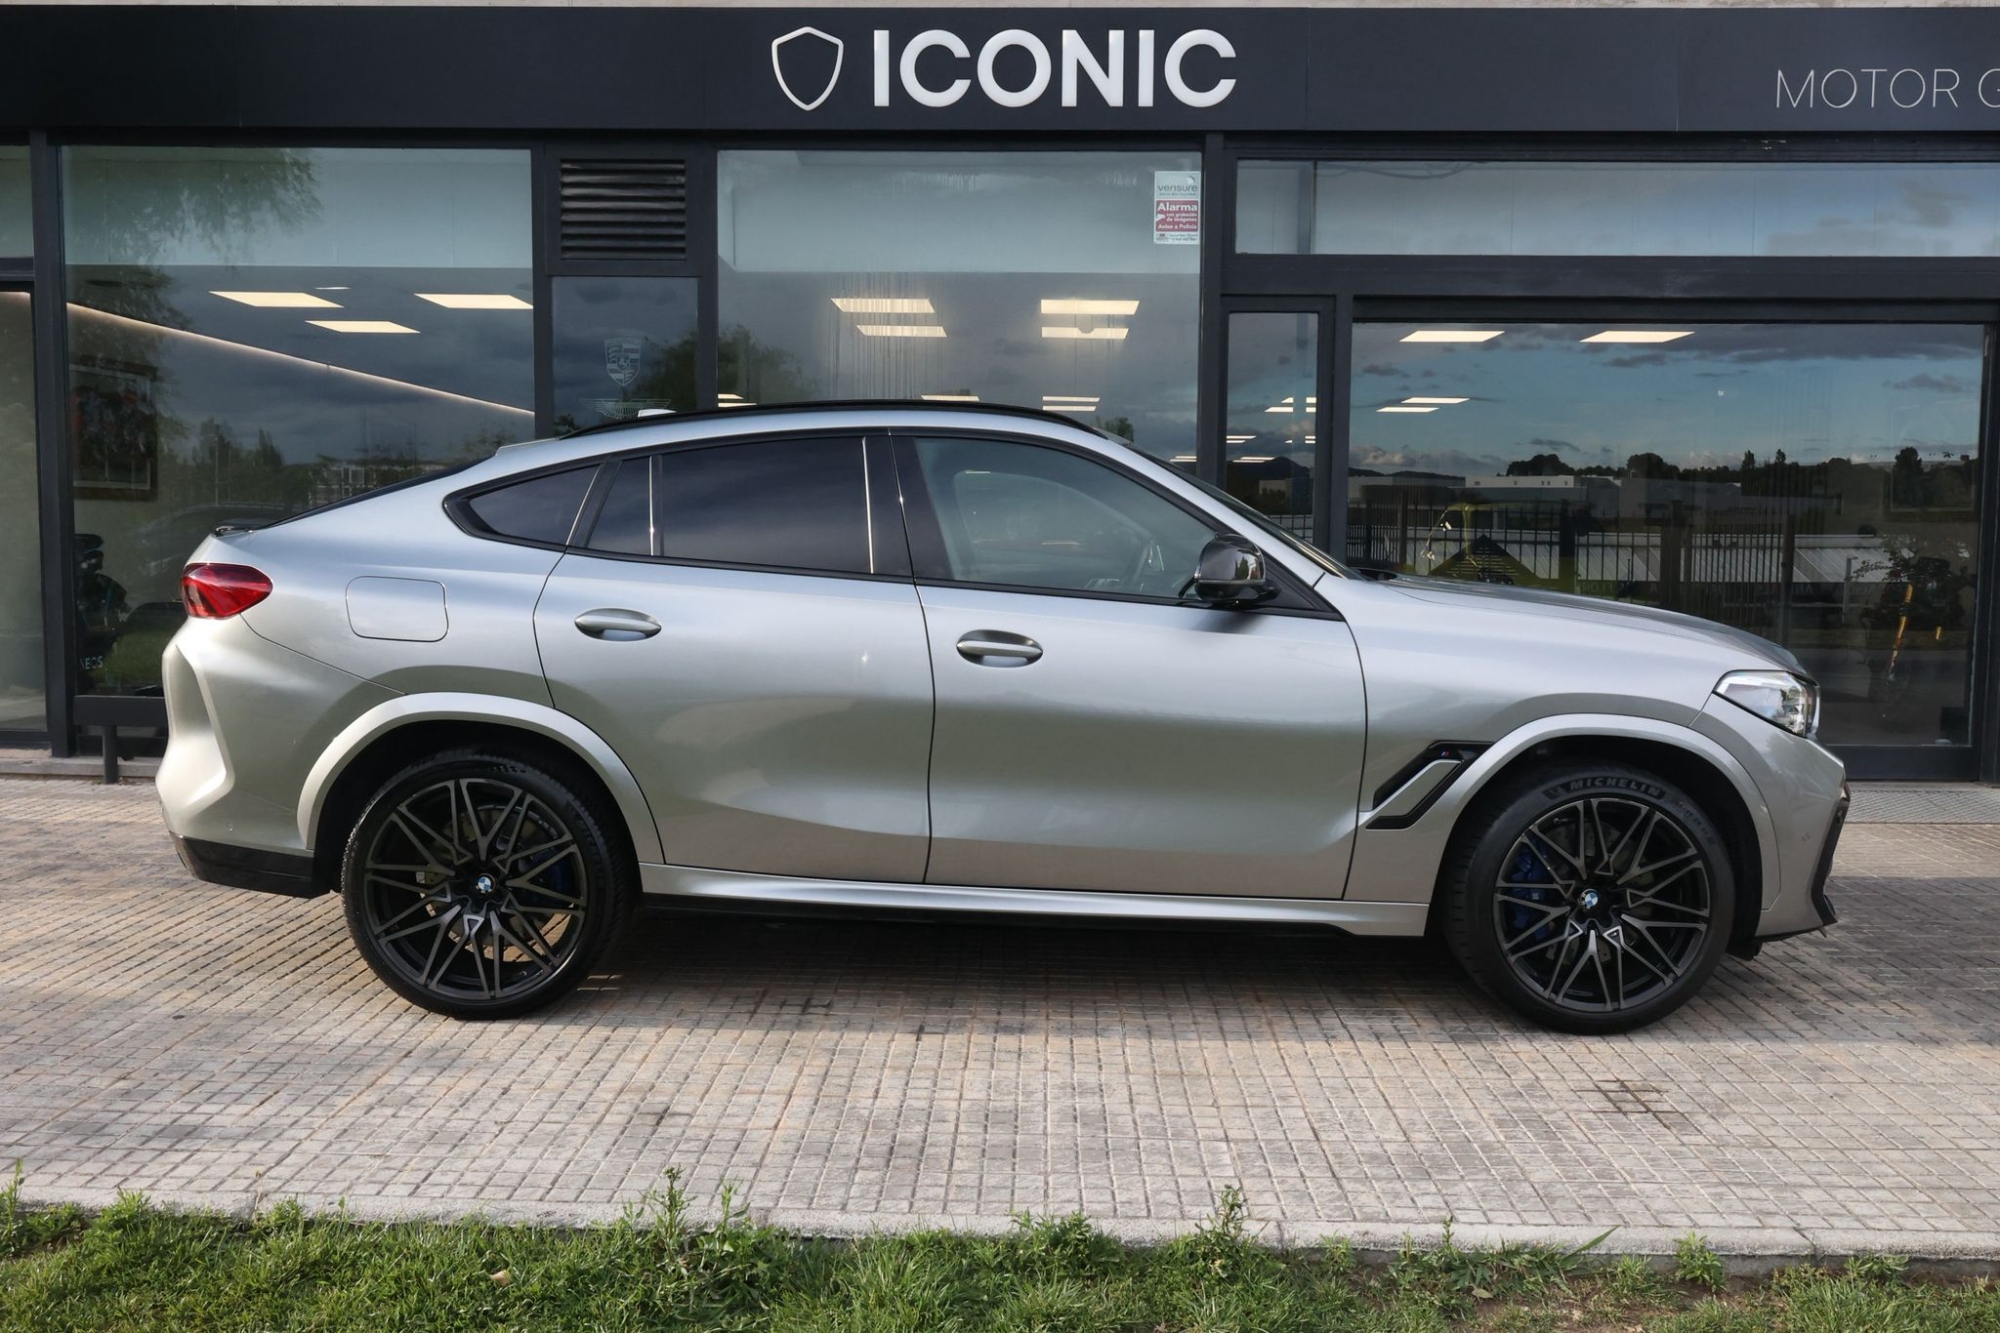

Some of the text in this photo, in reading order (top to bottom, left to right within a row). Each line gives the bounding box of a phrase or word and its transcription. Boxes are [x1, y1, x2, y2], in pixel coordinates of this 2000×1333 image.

[873, 28, 1237, 108] ICONIC
[1776, 68, 1960, 108] MOTOR
[1157, 184, 1198, 192] verisure
[1157, 202, 1198, 211] Alarma
[1569, 777, 1661, 799] MICHELIN
